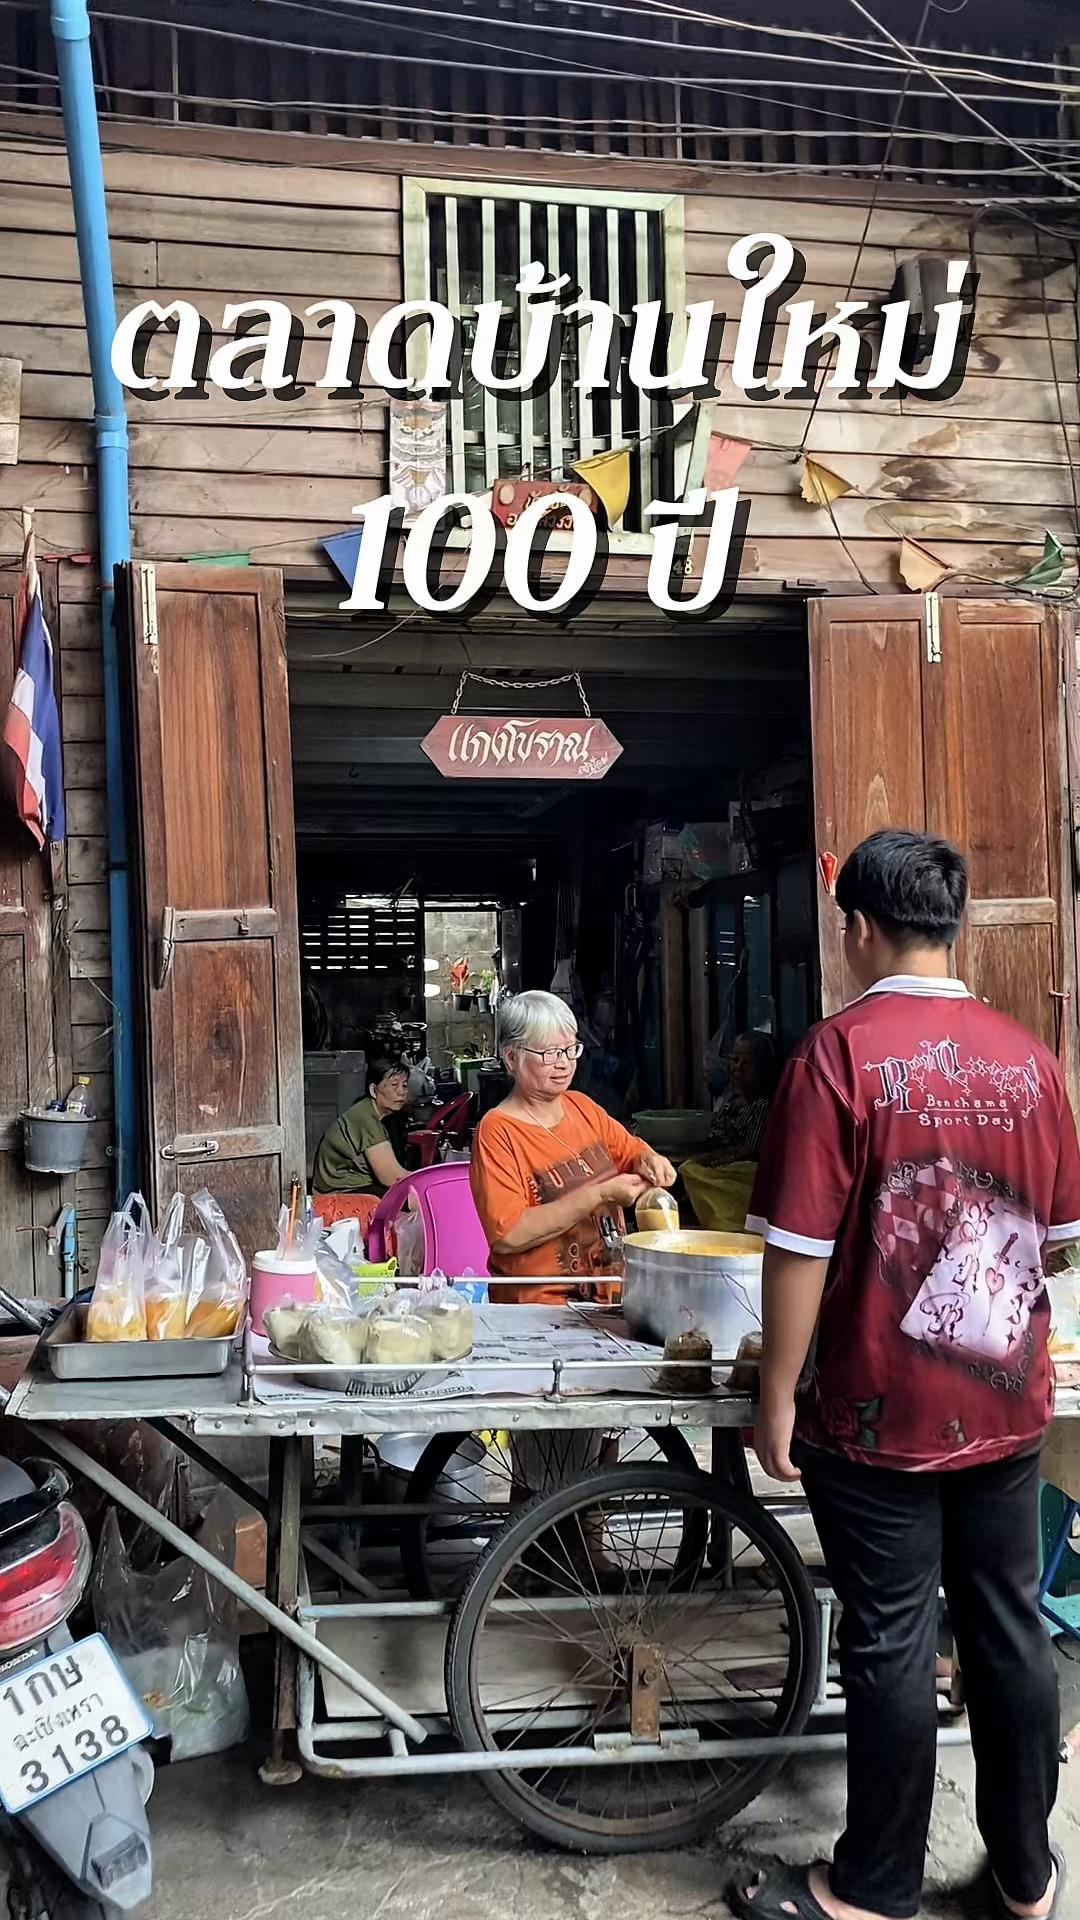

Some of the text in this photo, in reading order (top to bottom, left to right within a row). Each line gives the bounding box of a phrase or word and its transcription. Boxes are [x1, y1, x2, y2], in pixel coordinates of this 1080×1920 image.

[448, 720, 596, 767] แกงโบราณ
[918, 1114, 1014, 1132] Sport Day
[926, 1094, 1007, 1109] Benchama
[3, 1655, 83, 1716] 1กษ
[20, 1715, 129, 1793] 3138
